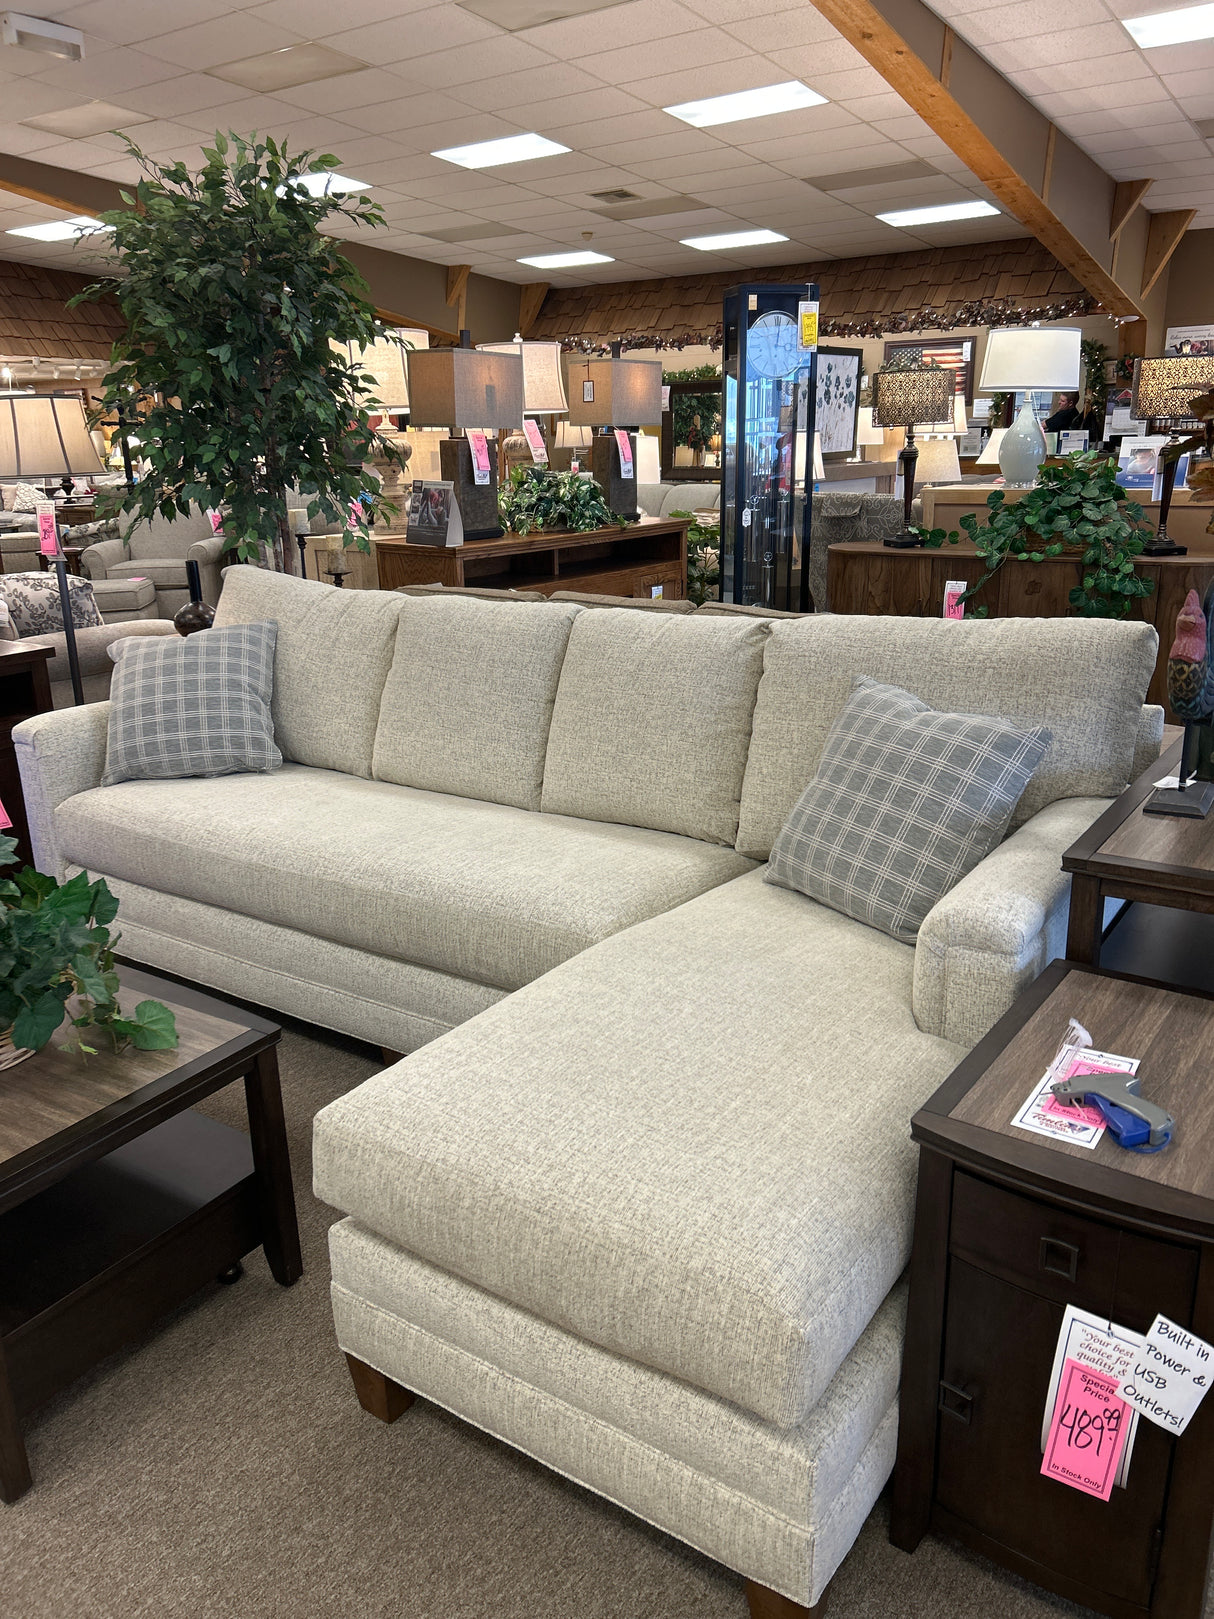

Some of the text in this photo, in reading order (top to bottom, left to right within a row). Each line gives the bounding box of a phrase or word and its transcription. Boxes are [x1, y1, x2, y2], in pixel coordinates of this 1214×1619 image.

[1112, 1344, 1135, 1359] best
[1157, 1321, 1210, 1361] Built in
[1076, 1351, 1115, 1373] quality
[1118, 1368, 1128, 1377] &
[1079, 1342, 1132, 1368] choice for
[1146, 1343, 1206, 1387] Power &
[1080, 1374, 1115, 1395] Specia
[1134, 1363, 1167, 1389] USB
[1083, 1386, 1110, 1403] Price
[1123, 1384, 1184, 1428] Outlets!
[1051, 1463, 1101, 1489] In Stock Only
